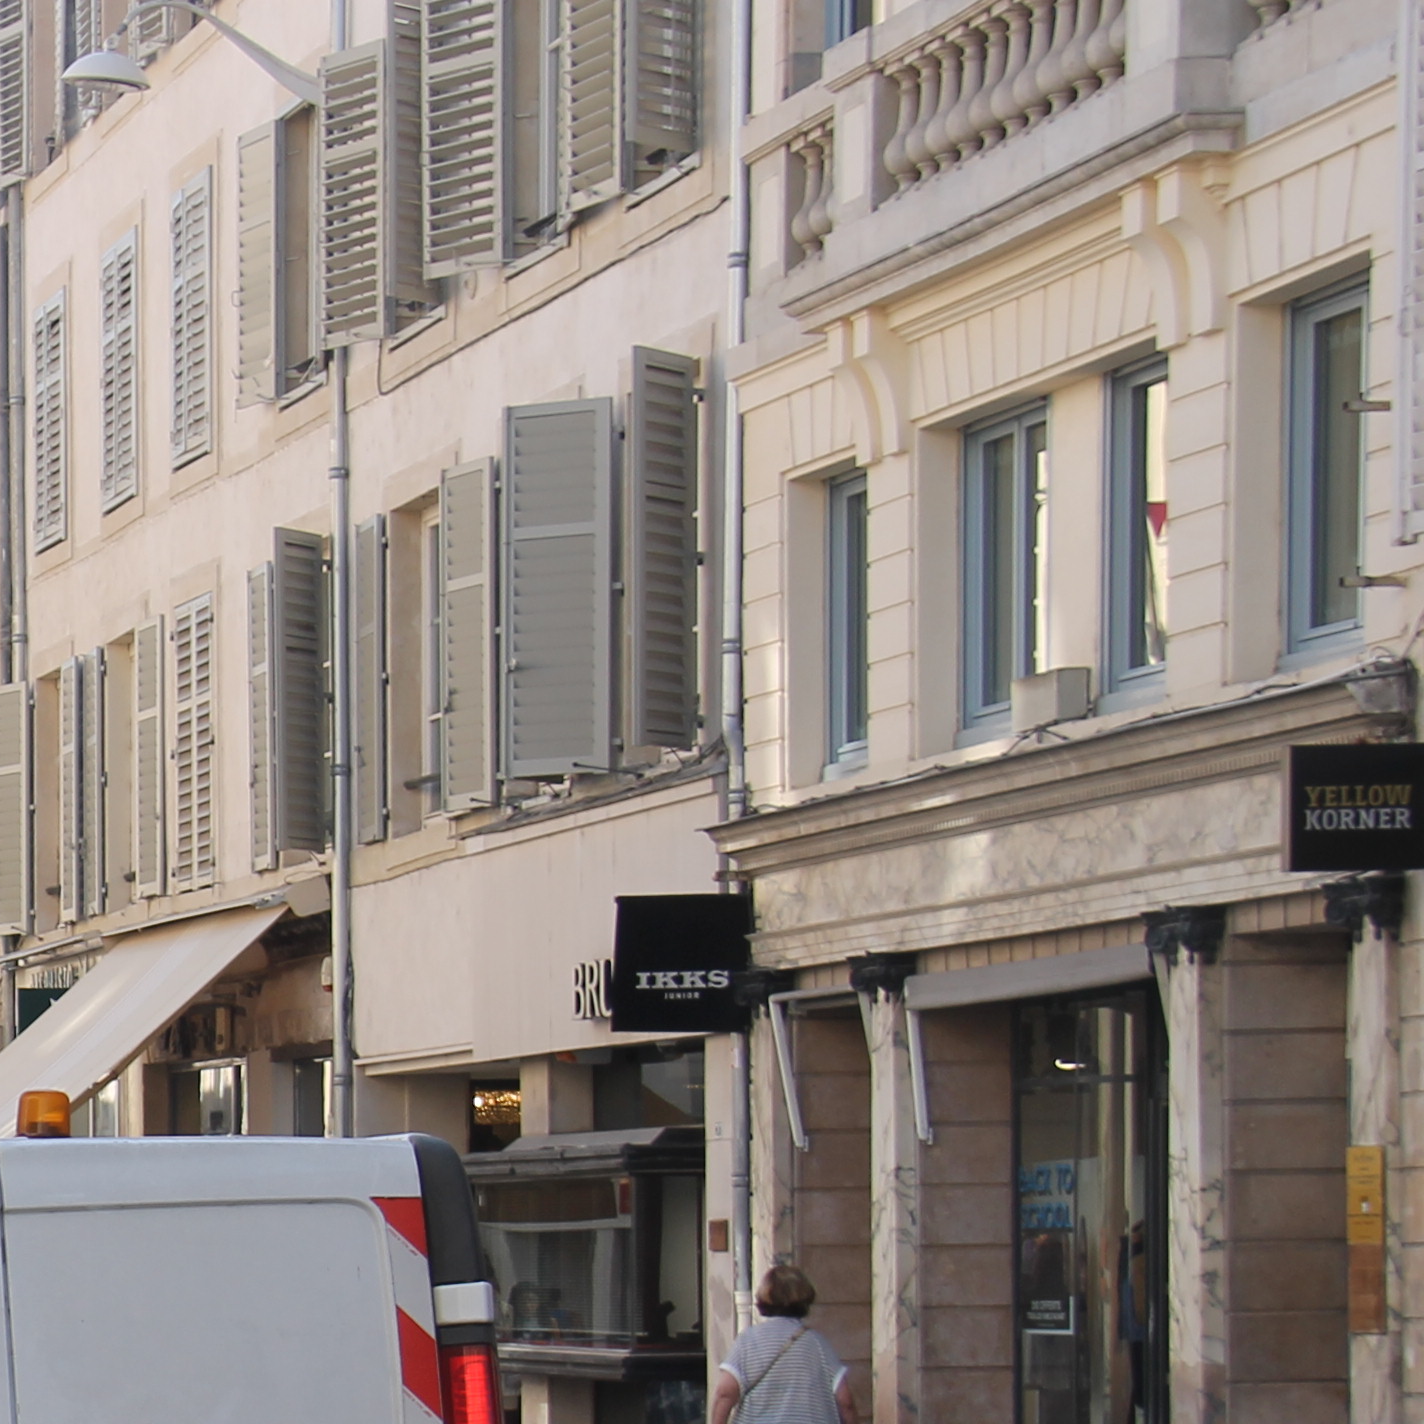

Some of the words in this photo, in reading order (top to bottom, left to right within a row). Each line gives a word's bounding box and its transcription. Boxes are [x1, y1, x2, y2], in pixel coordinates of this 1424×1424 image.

[1304, 784, 1412, 807] YELLOW
[1304, 808, 1412, 830] KORNER
[635, 970, 729, 989] IKKS
